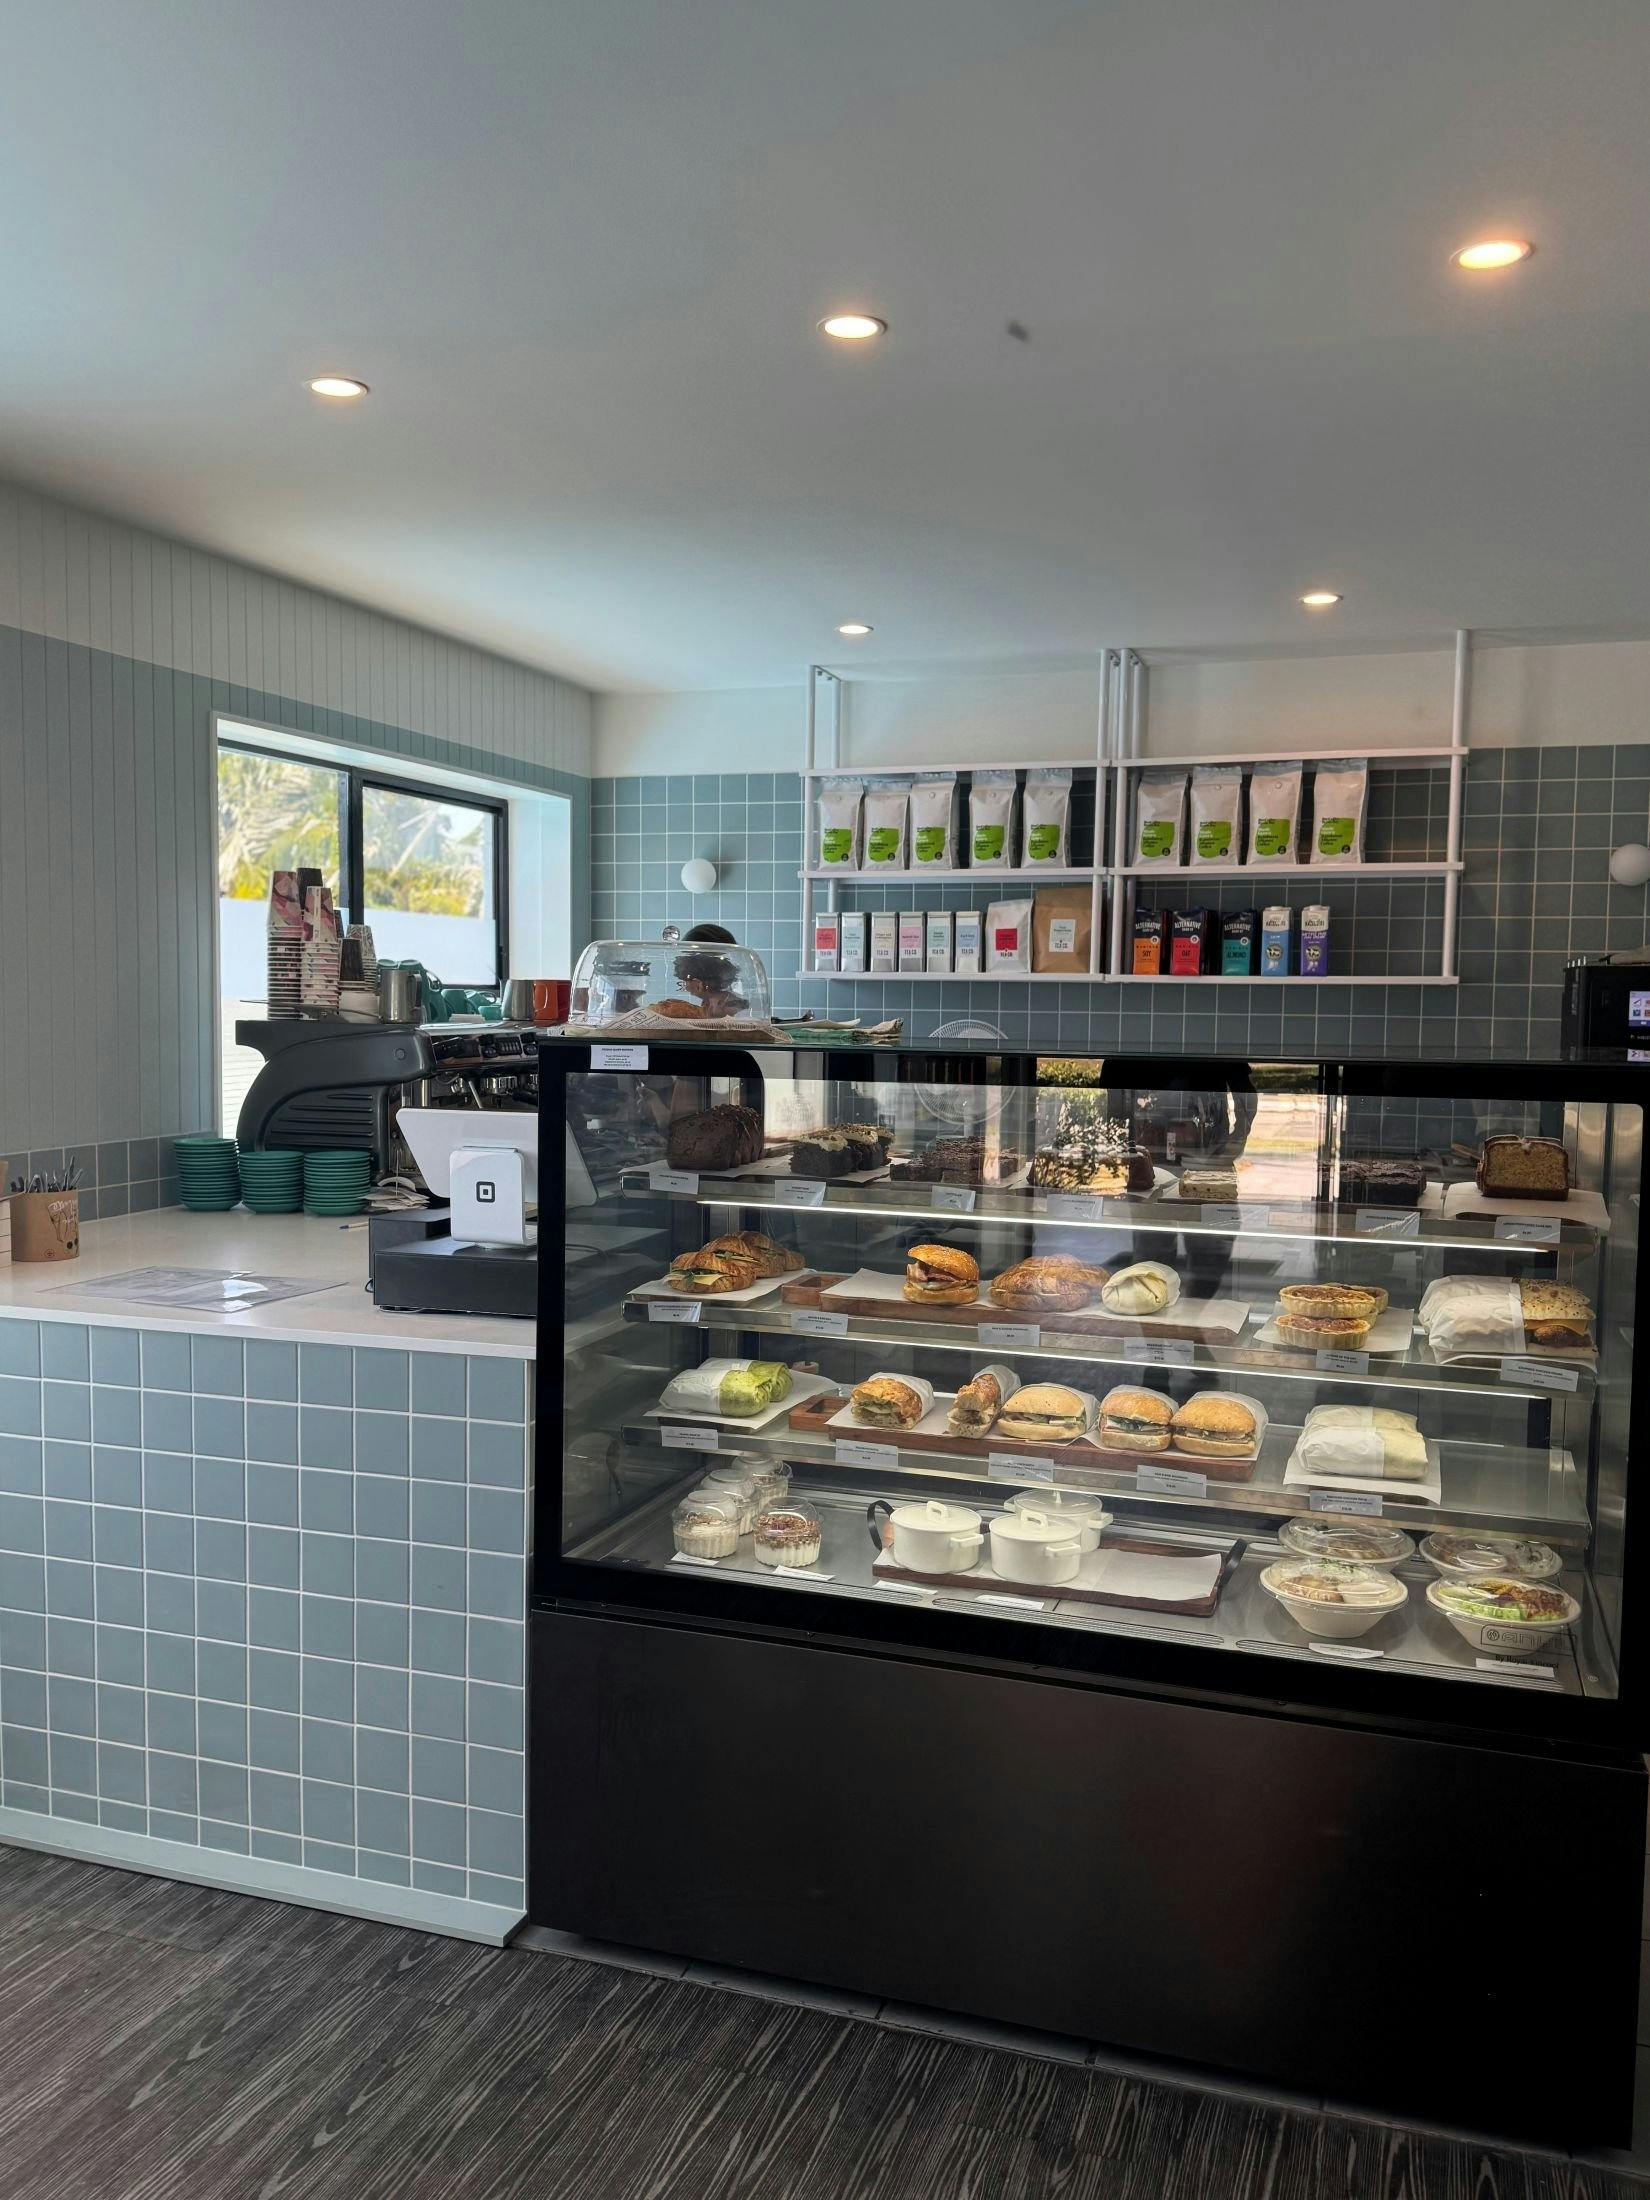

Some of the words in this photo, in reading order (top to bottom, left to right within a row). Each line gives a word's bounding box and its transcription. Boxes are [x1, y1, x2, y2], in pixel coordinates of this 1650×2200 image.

[1136, 921, 1161, 930] ALTERNATIVE
[1175, 921, 1201, 930] ALTERNATIVE
[1224, 923, 1250, 931] ALTERNATIVE
